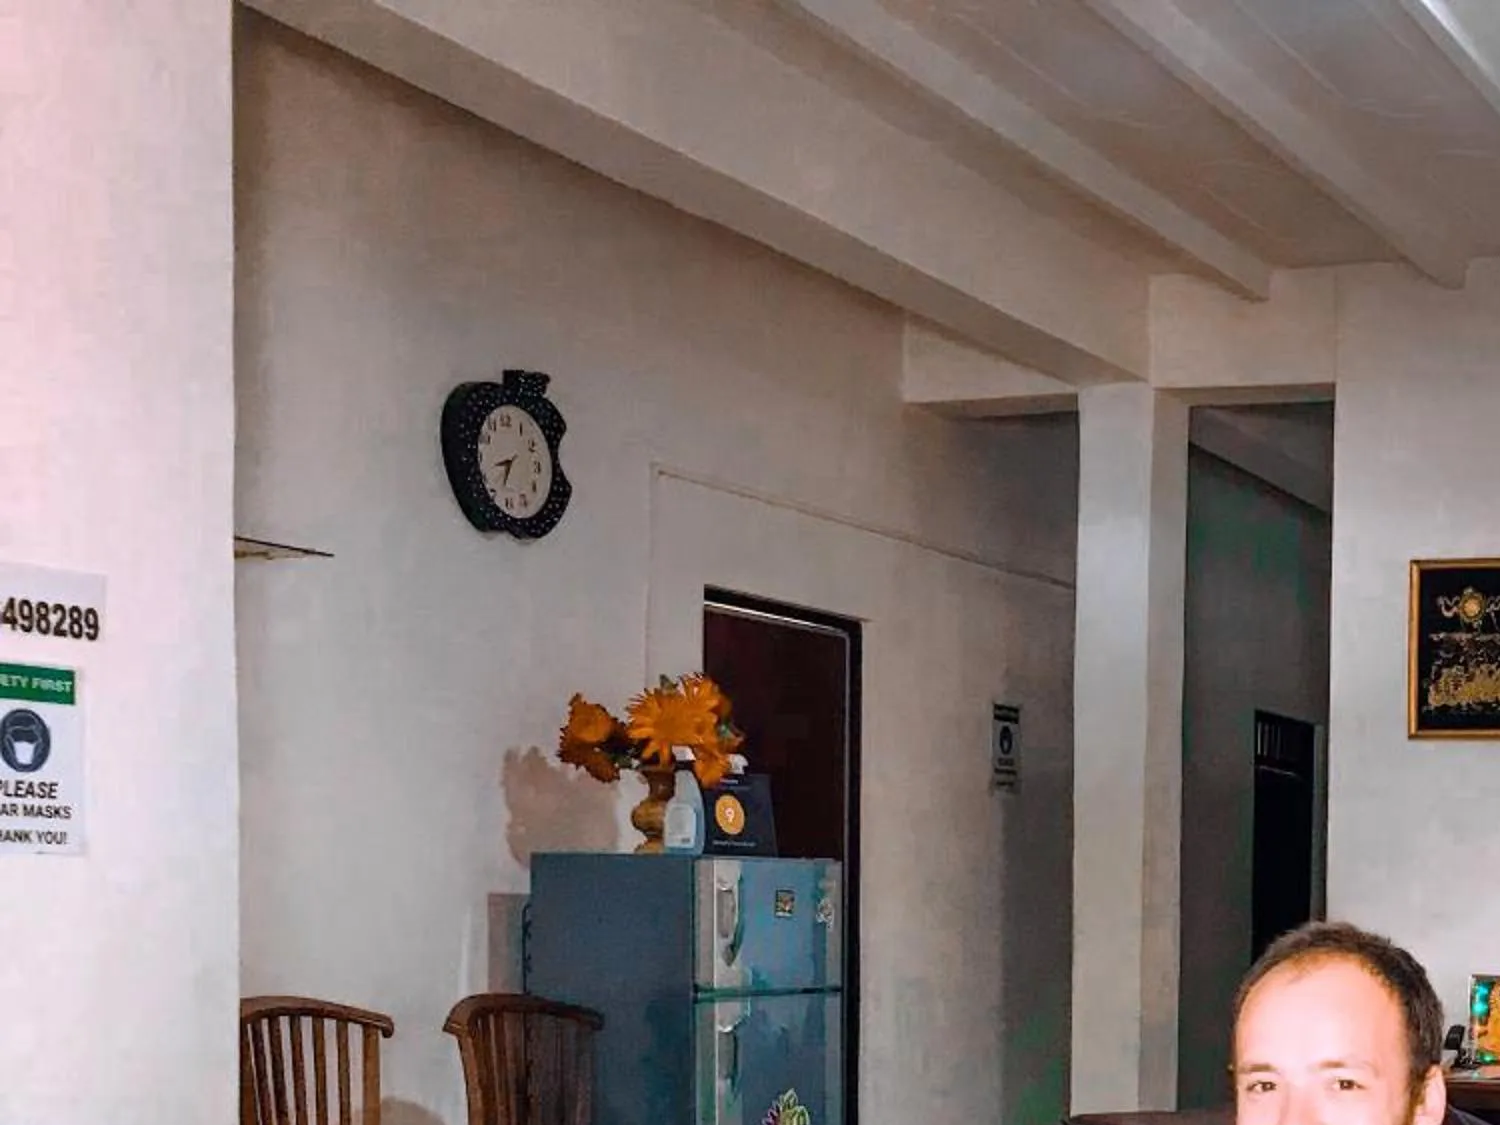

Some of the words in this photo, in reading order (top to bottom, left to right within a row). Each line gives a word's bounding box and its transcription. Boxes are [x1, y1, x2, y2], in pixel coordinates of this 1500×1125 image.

[0, 597, 99, 641] 498289
[32, 677, 73, 694] FIRST
[23, 804, 72, 819] MASKS
